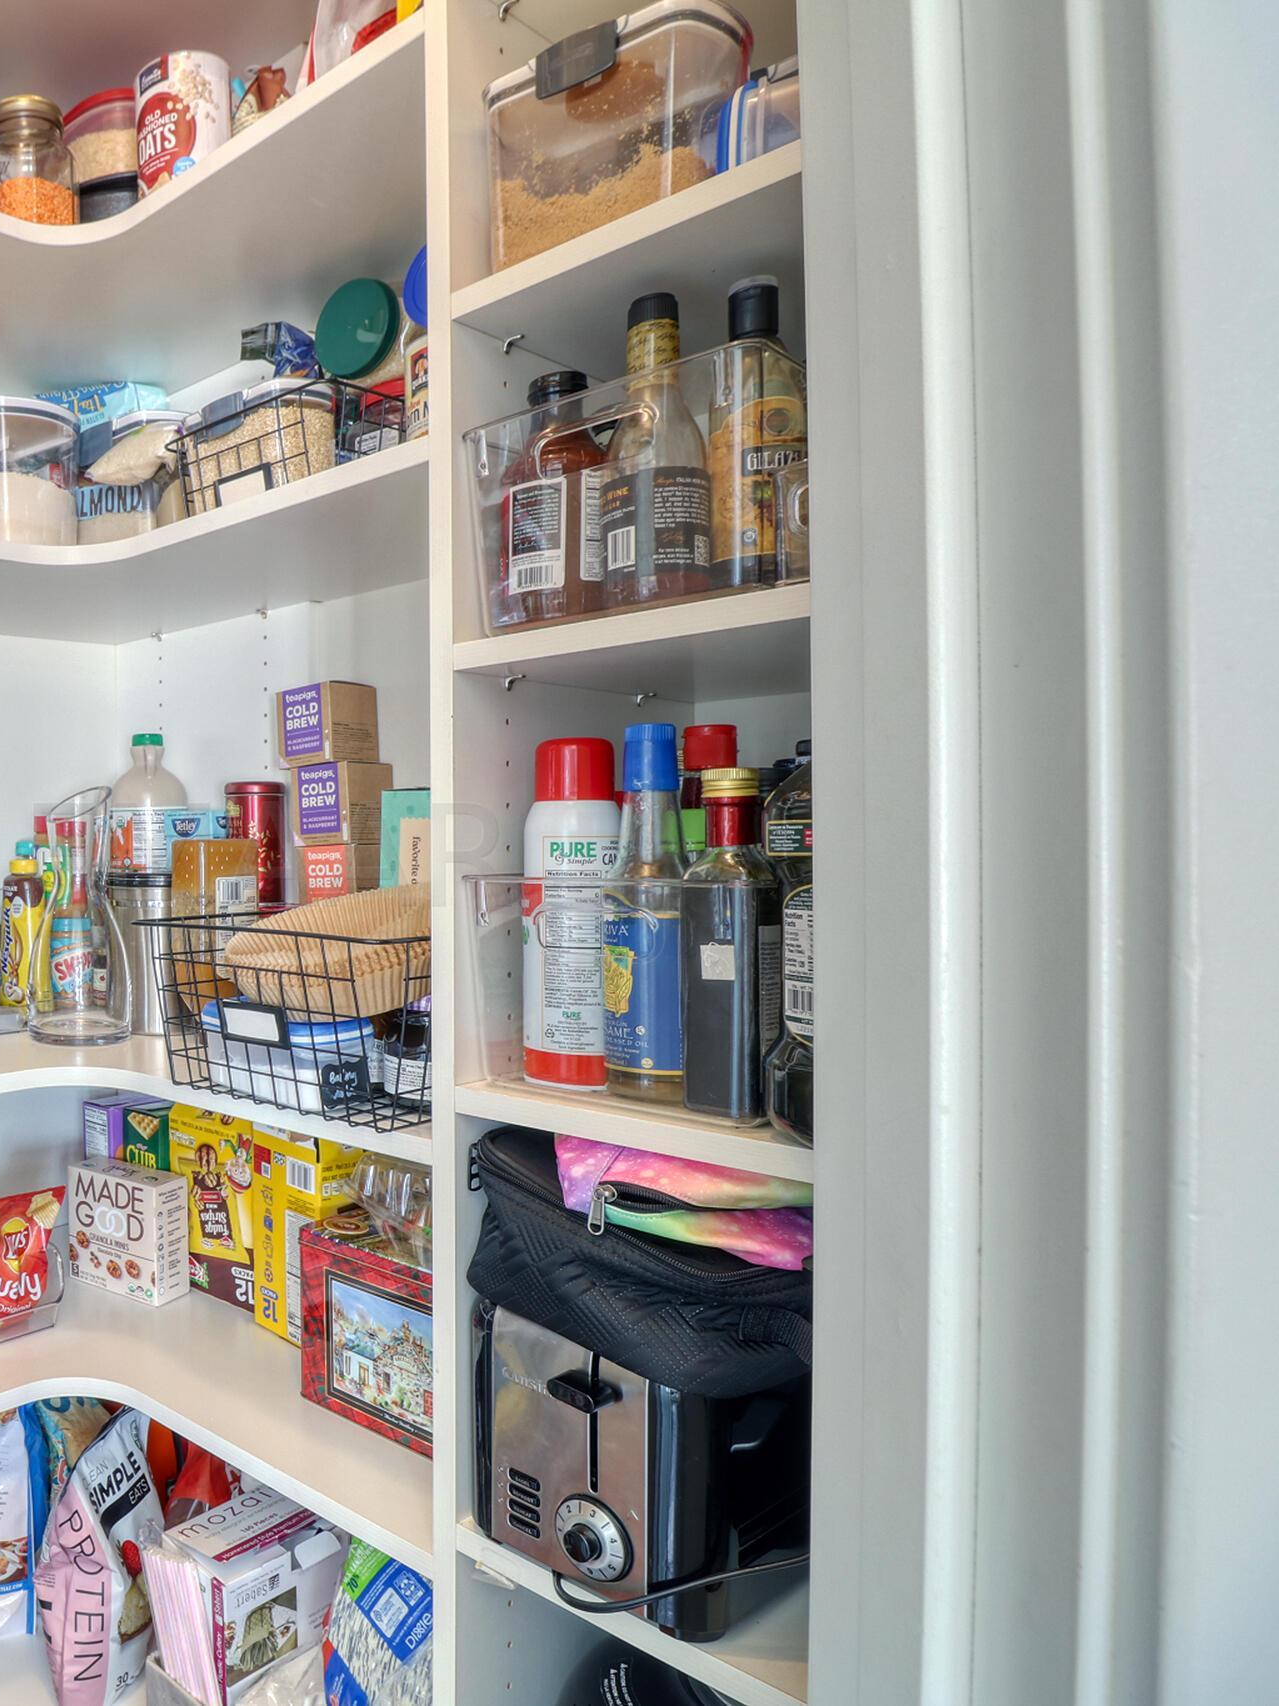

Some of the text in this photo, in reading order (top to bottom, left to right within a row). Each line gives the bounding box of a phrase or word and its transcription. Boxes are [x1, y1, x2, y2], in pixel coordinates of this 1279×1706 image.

[139, 124, 177, 165] OATS
[286, 702, 318, 718] COLD
[286, 715, 319, 731] BREW
[301, 782, 336, 797] COLD
[301, 795, 336, 808] BREW
[174, 820, 196, 835] Tetley
[411, 836, 421, 877] favorite
[549, 841, 598, 858] PURE
[308, 863, 343, 876] COLD
[308, 876, 343, 889] BREW
[1, 908, 12, 975] Nesquik
[75, 1170, 144, 1216] MADE
[75, 1200, 145, 1242] GOOD
[201, 1210, 228, 1225] Stripes
[204, 1222, 230, 1238] Fudge
[88, 1232, 114, 1248] GRANOLA
[235, 1280, 254, 1303] 12
[262, 1298, 278, 1323] 12
[90, 1451, 141, 1513] SIMPLE
[128, 1480, 149, 1505] EATS
[566, 1504, 572, 1513] 2
[590, 1509, 596, 1518] 3
[610, 1536, 618, 1544] 4
[608, 1563, 616, 1571] 5
[58, 1510, 105, 1683] PROTEIN
